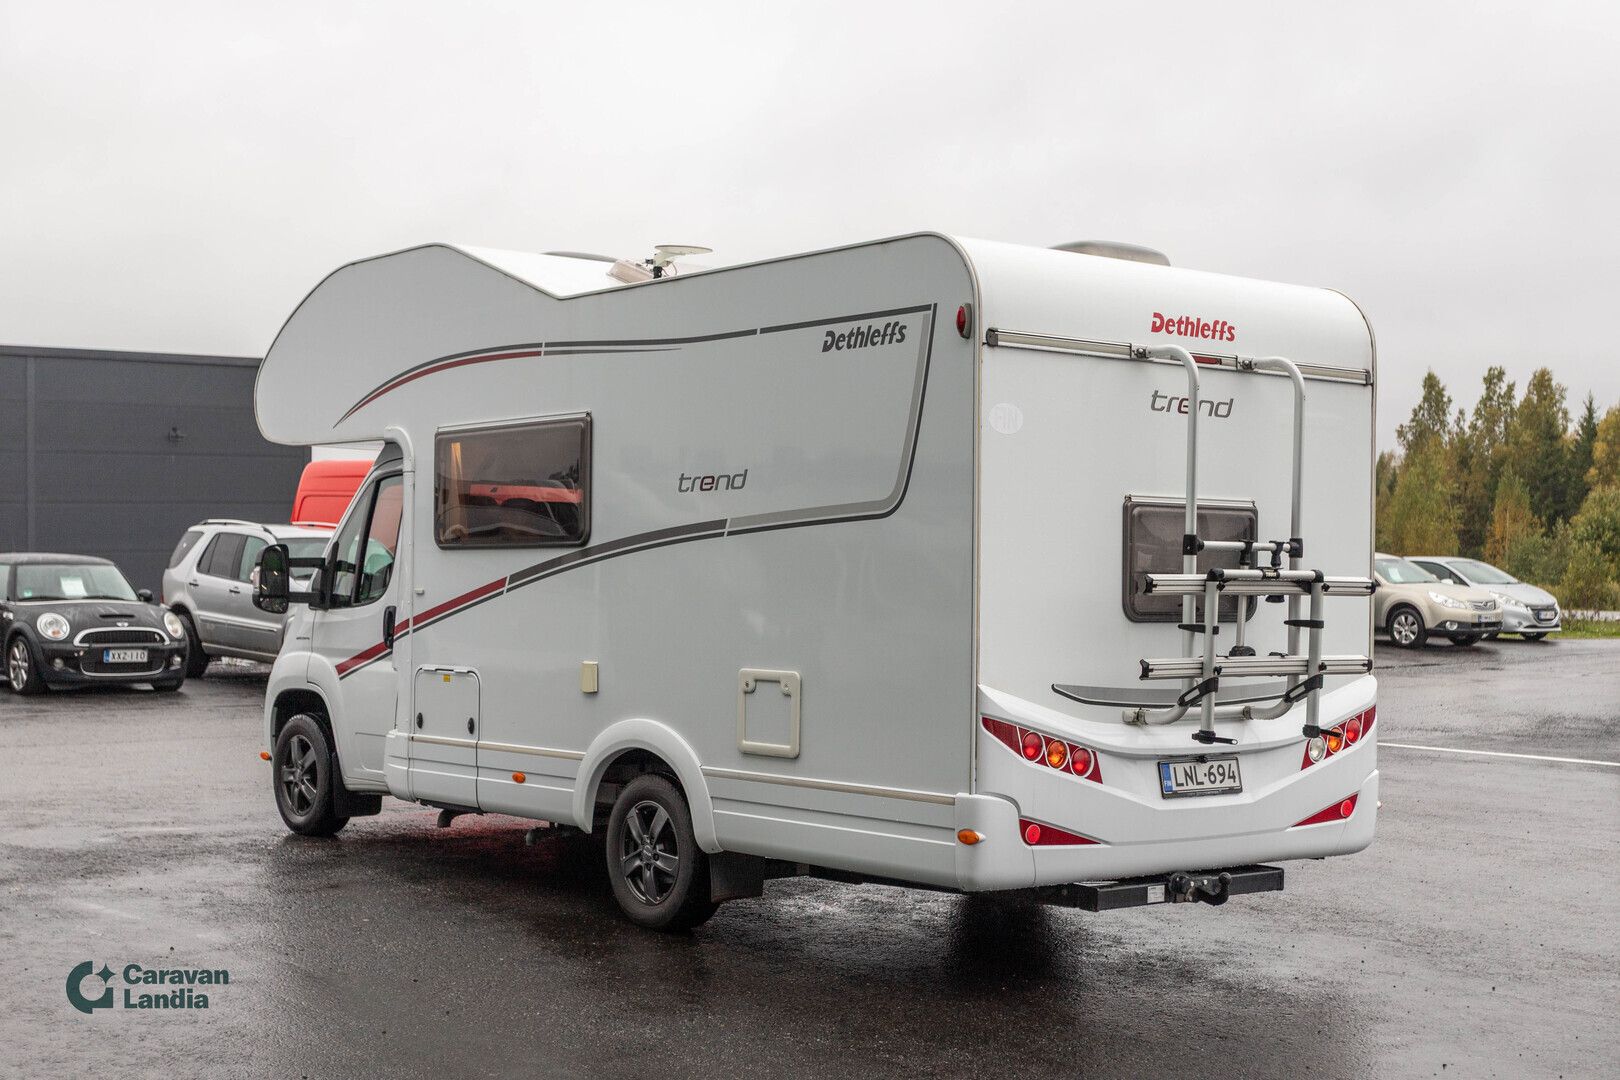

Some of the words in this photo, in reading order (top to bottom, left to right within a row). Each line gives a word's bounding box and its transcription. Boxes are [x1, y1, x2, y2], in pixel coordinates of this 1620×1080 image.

[822, 321, 907, 353] Dethleffs
[1151, 312, 1235, 342] Dethleffs
[1151, 390, 1234, 419] trend
[678, 468, 748, 493] trend
[1173, 763, 1237, 787] LNL-694
